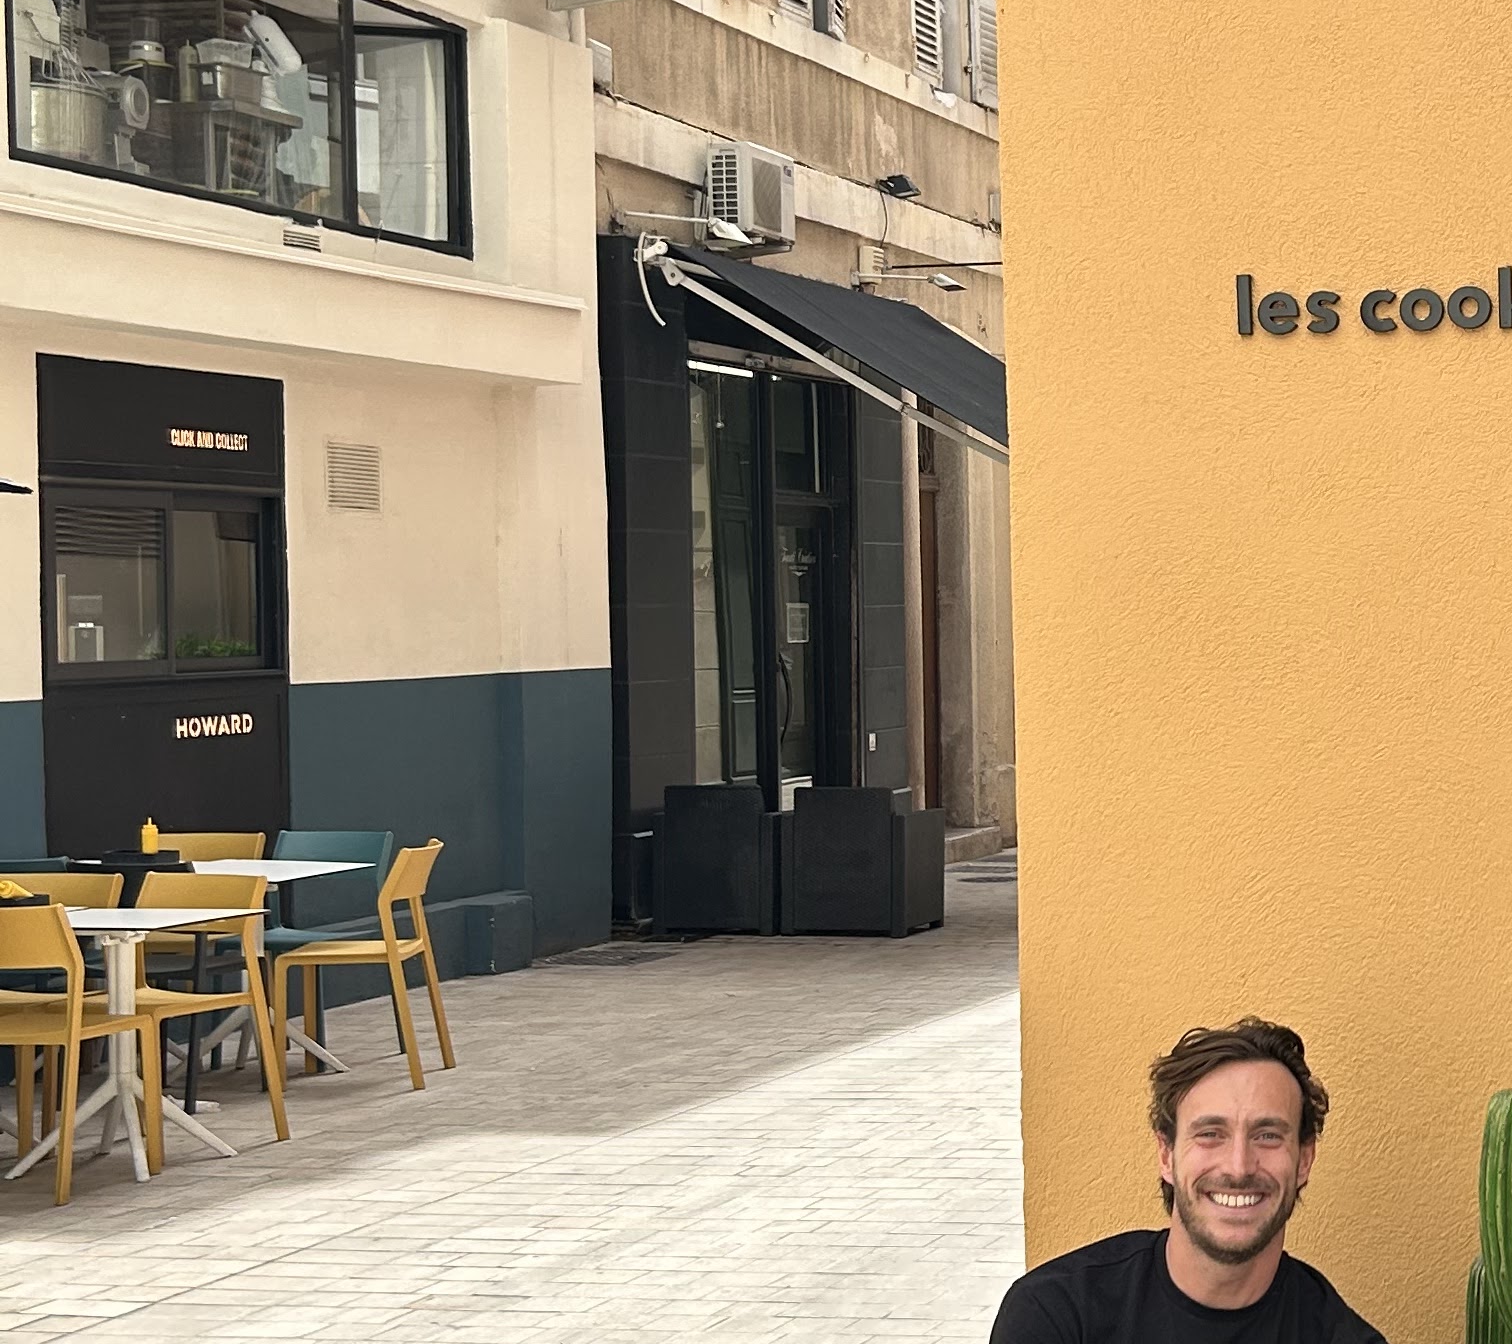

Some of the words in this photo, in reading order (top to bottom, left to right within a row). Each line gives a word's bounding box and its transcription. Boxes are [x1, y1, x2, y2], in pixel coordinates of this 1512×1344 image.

[1235, 274, 1342, 338] les
[196, 430, 215, 449] AND
[215, 432, 249, 452] COLLECT
[175, 713, 254, 739] HOWARD
